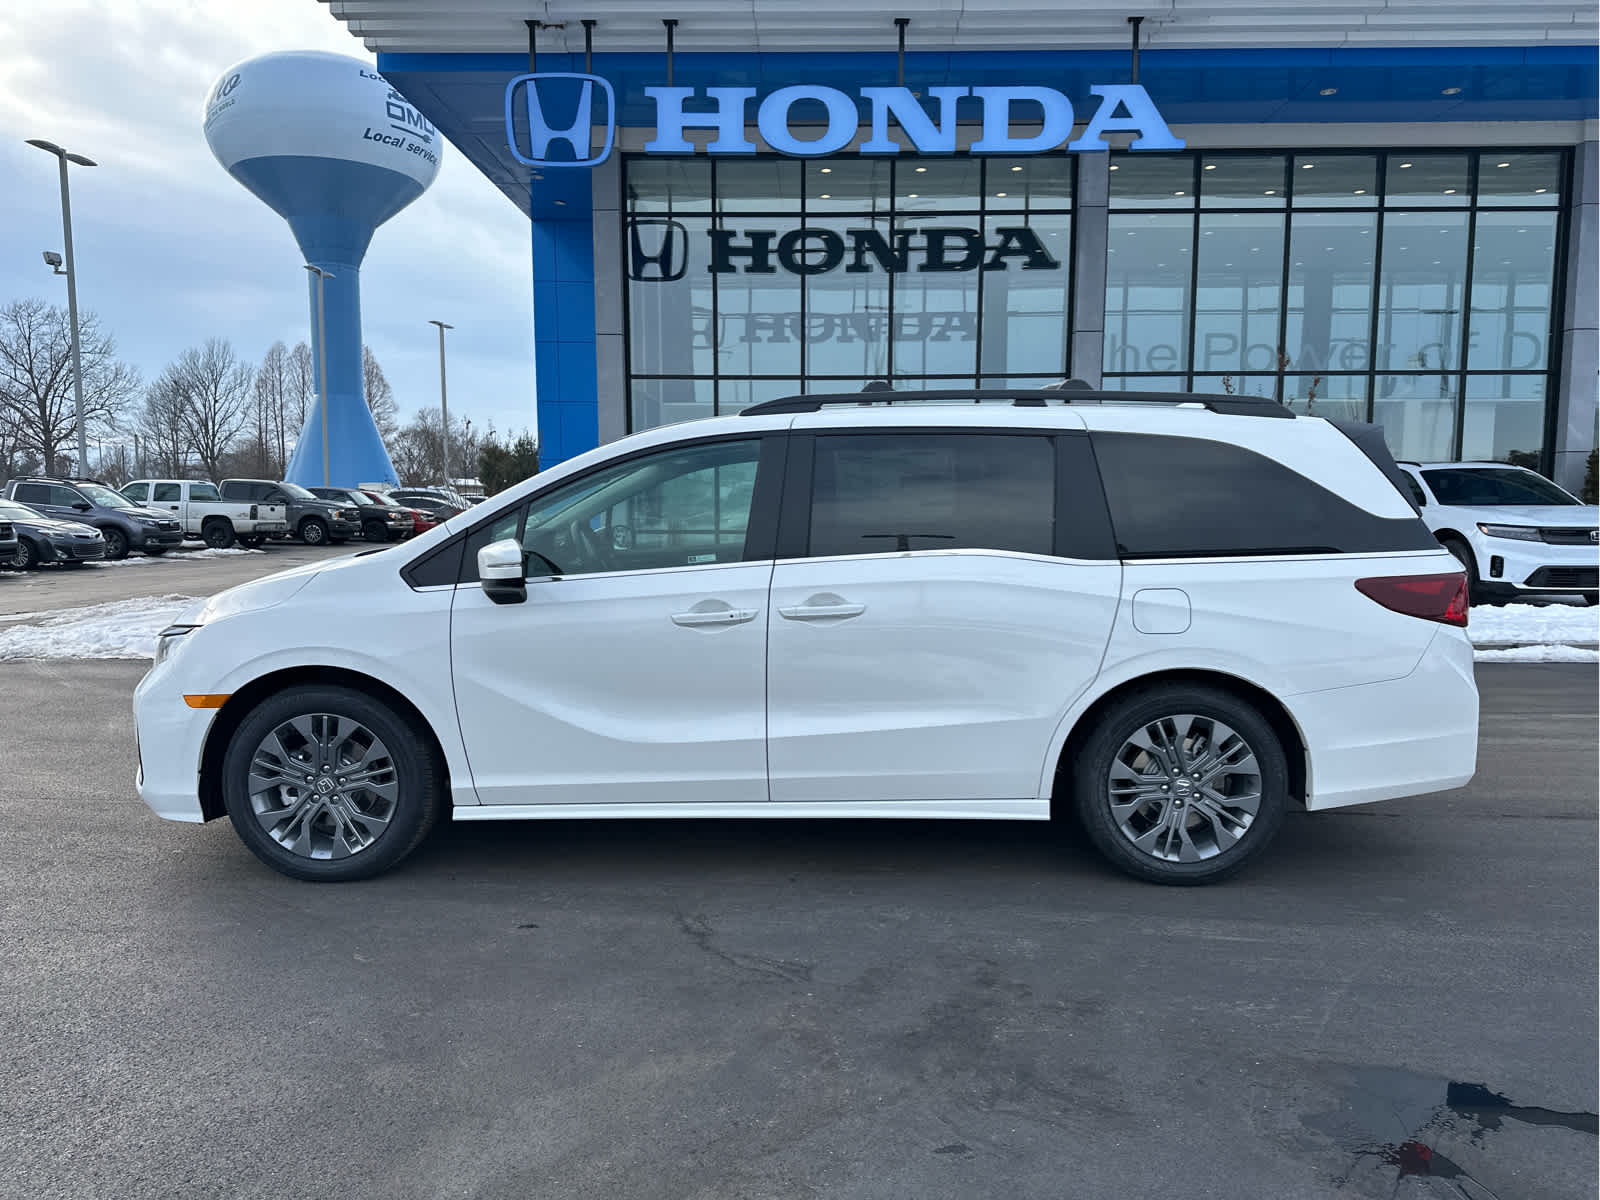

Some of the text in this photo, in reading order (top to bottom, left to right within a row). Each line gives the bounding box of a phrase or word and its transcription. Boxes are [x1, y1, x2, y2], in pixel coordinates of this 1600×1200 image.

[363, 127, 405, 148] Local
[644, 84, 1186, 156] HONDA
[707, 226, 1060, 274] HONDA
